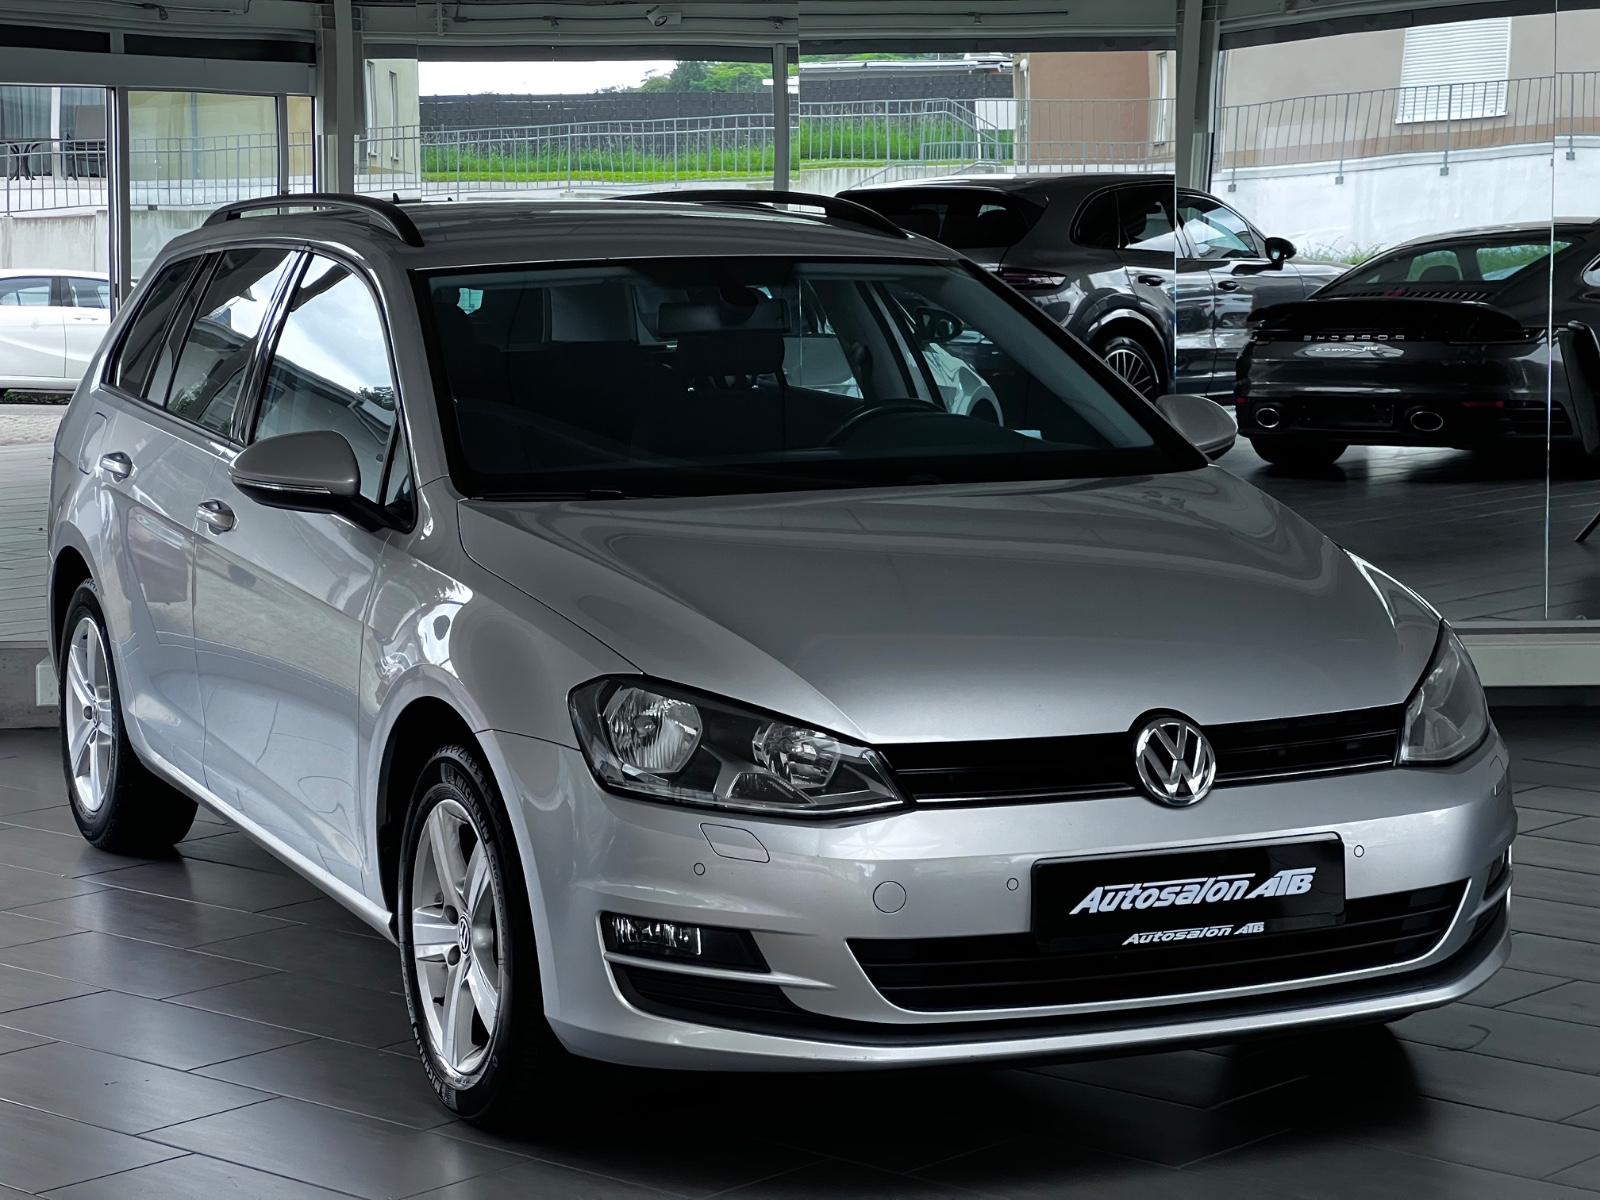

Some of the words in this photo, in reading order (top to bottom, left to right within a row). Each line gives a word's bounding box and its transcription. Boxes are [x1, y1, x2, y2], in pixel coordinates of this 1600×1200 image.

[455, 776, 490, 841] MICHELIN
[1069, 873, 1256, 915] Autosalon
[1244, 867, 1317, 899] ATB
[1121, 924, 1234, 946] Autosalon
[1234, 921, 1265, 935] ATB
[413, 1027, 442, 1094] MICHELIN
